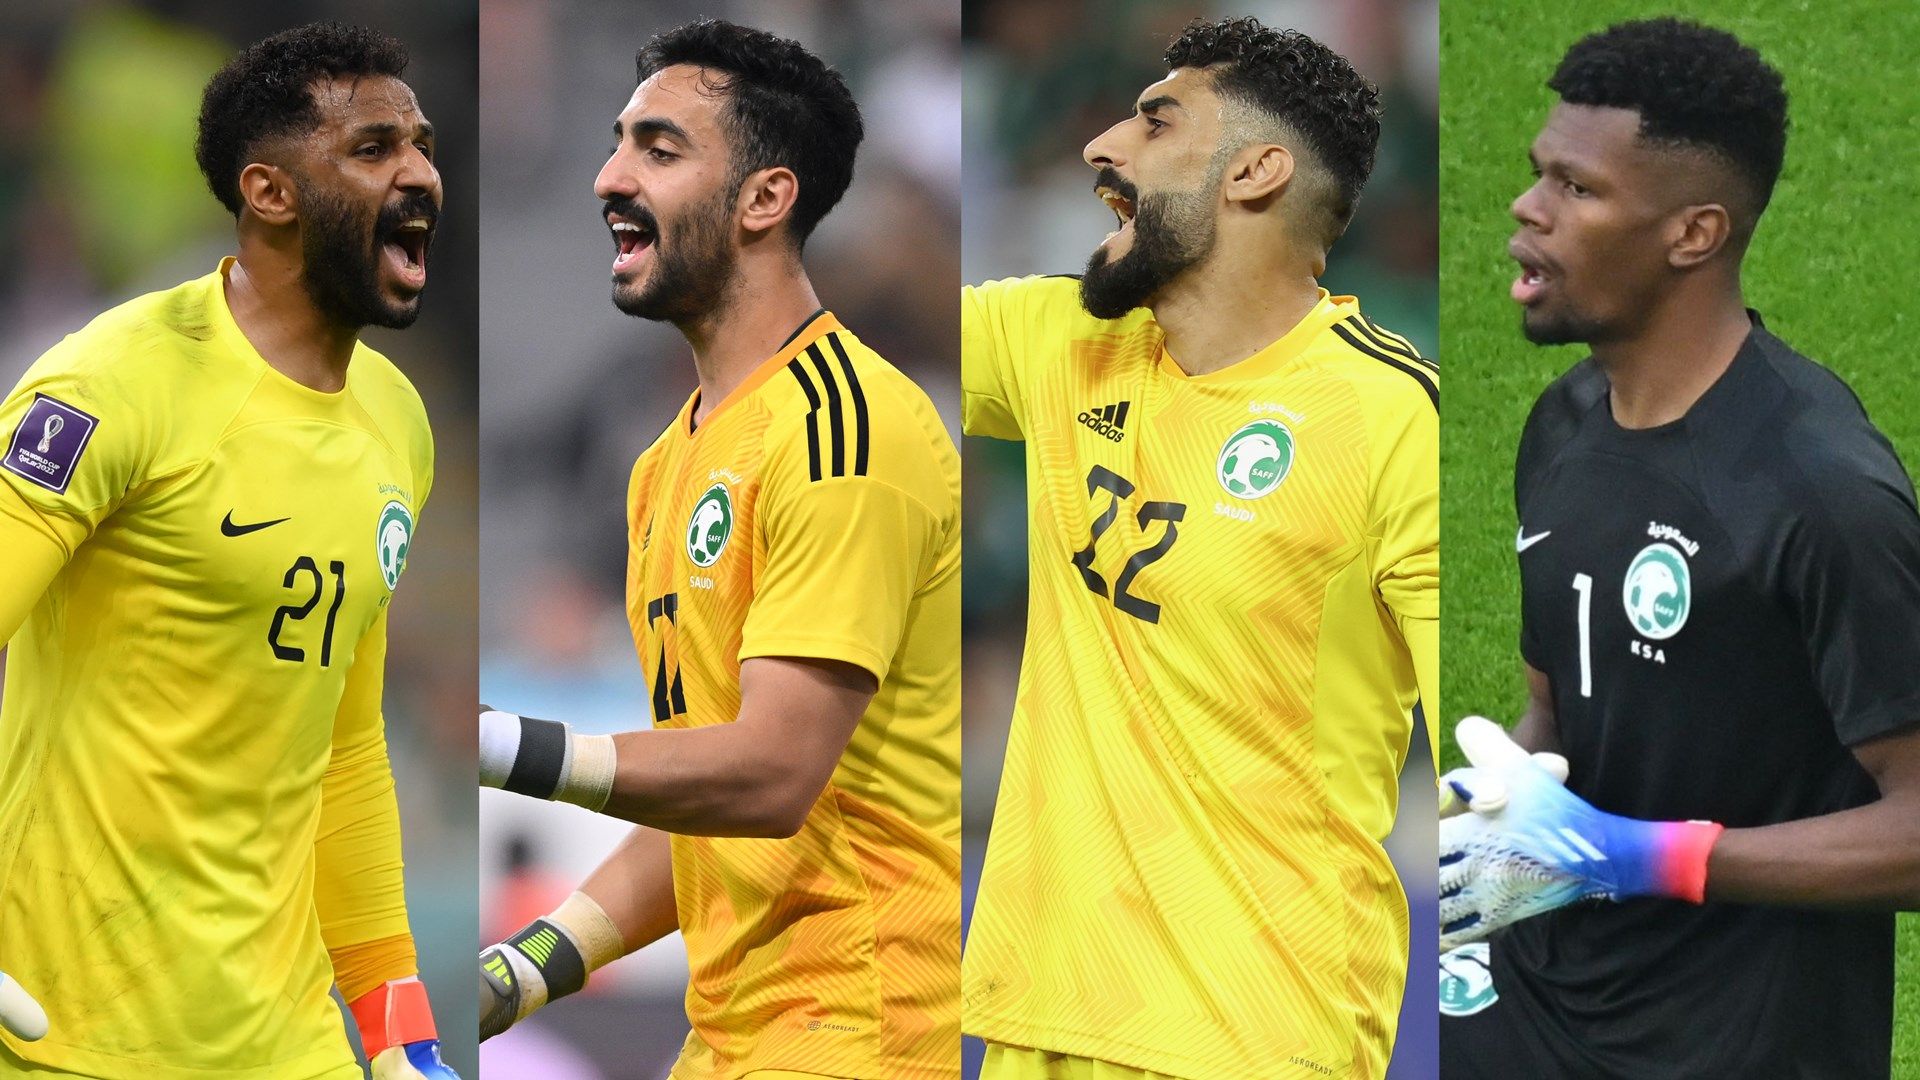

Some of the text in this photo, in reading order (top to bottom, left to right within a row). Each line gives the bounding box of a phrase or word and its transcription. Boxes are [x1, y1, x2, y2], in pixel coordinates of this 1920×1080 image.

[1077, 410, 1125, 443] adidas
[19, 447, 61, 470] FIFA WORLD CUP
[1250, 467, 1275, 480] SAFF
[1213, 502, 1256, 523] SAUDI
[707, 534, 722, 544] SAFF
[1071, 464, 1187, 625] 22
[690, 575, 715, 590] SAUDI
[267, 555, 345, 667] 21
[1572, 572, 1593, 698] 1
[1630, 640, 1666, 664] KSA
[822, 1023, 860, 1033] AEROREADY
[1288, 1055, 1334, 1077] AEROREADY
